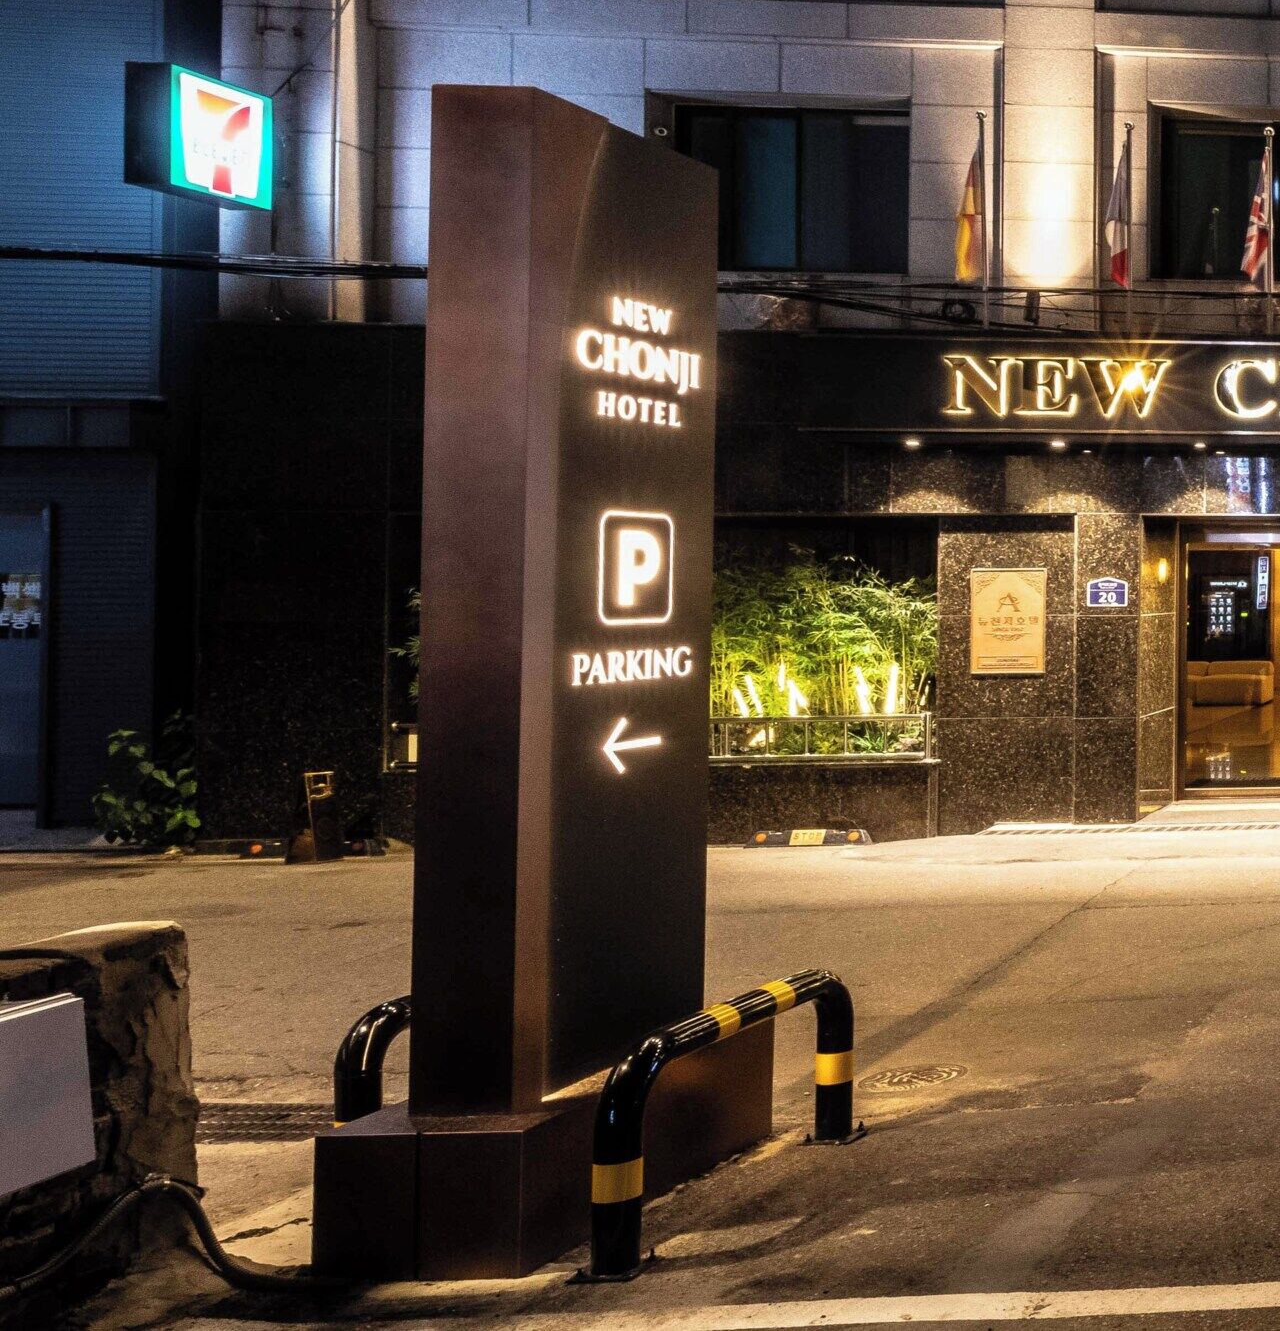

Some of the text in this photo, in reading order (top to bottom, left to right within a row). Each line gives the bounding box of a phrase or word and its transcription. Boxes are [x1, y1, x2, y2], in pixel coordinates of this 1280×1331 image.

[611, 296, 673, 336] NEW
[575, 328, 701, 396] CHONJI
[943, 355, 1172, 420] NEW
[597, 390, 682, 428] HOTEL
[617, 528, 662, 607] P
[1098, 591, 1117, 603] 20
[571, 646, 693, 687] PARKING
[793, 832, 823, 840] STOP
